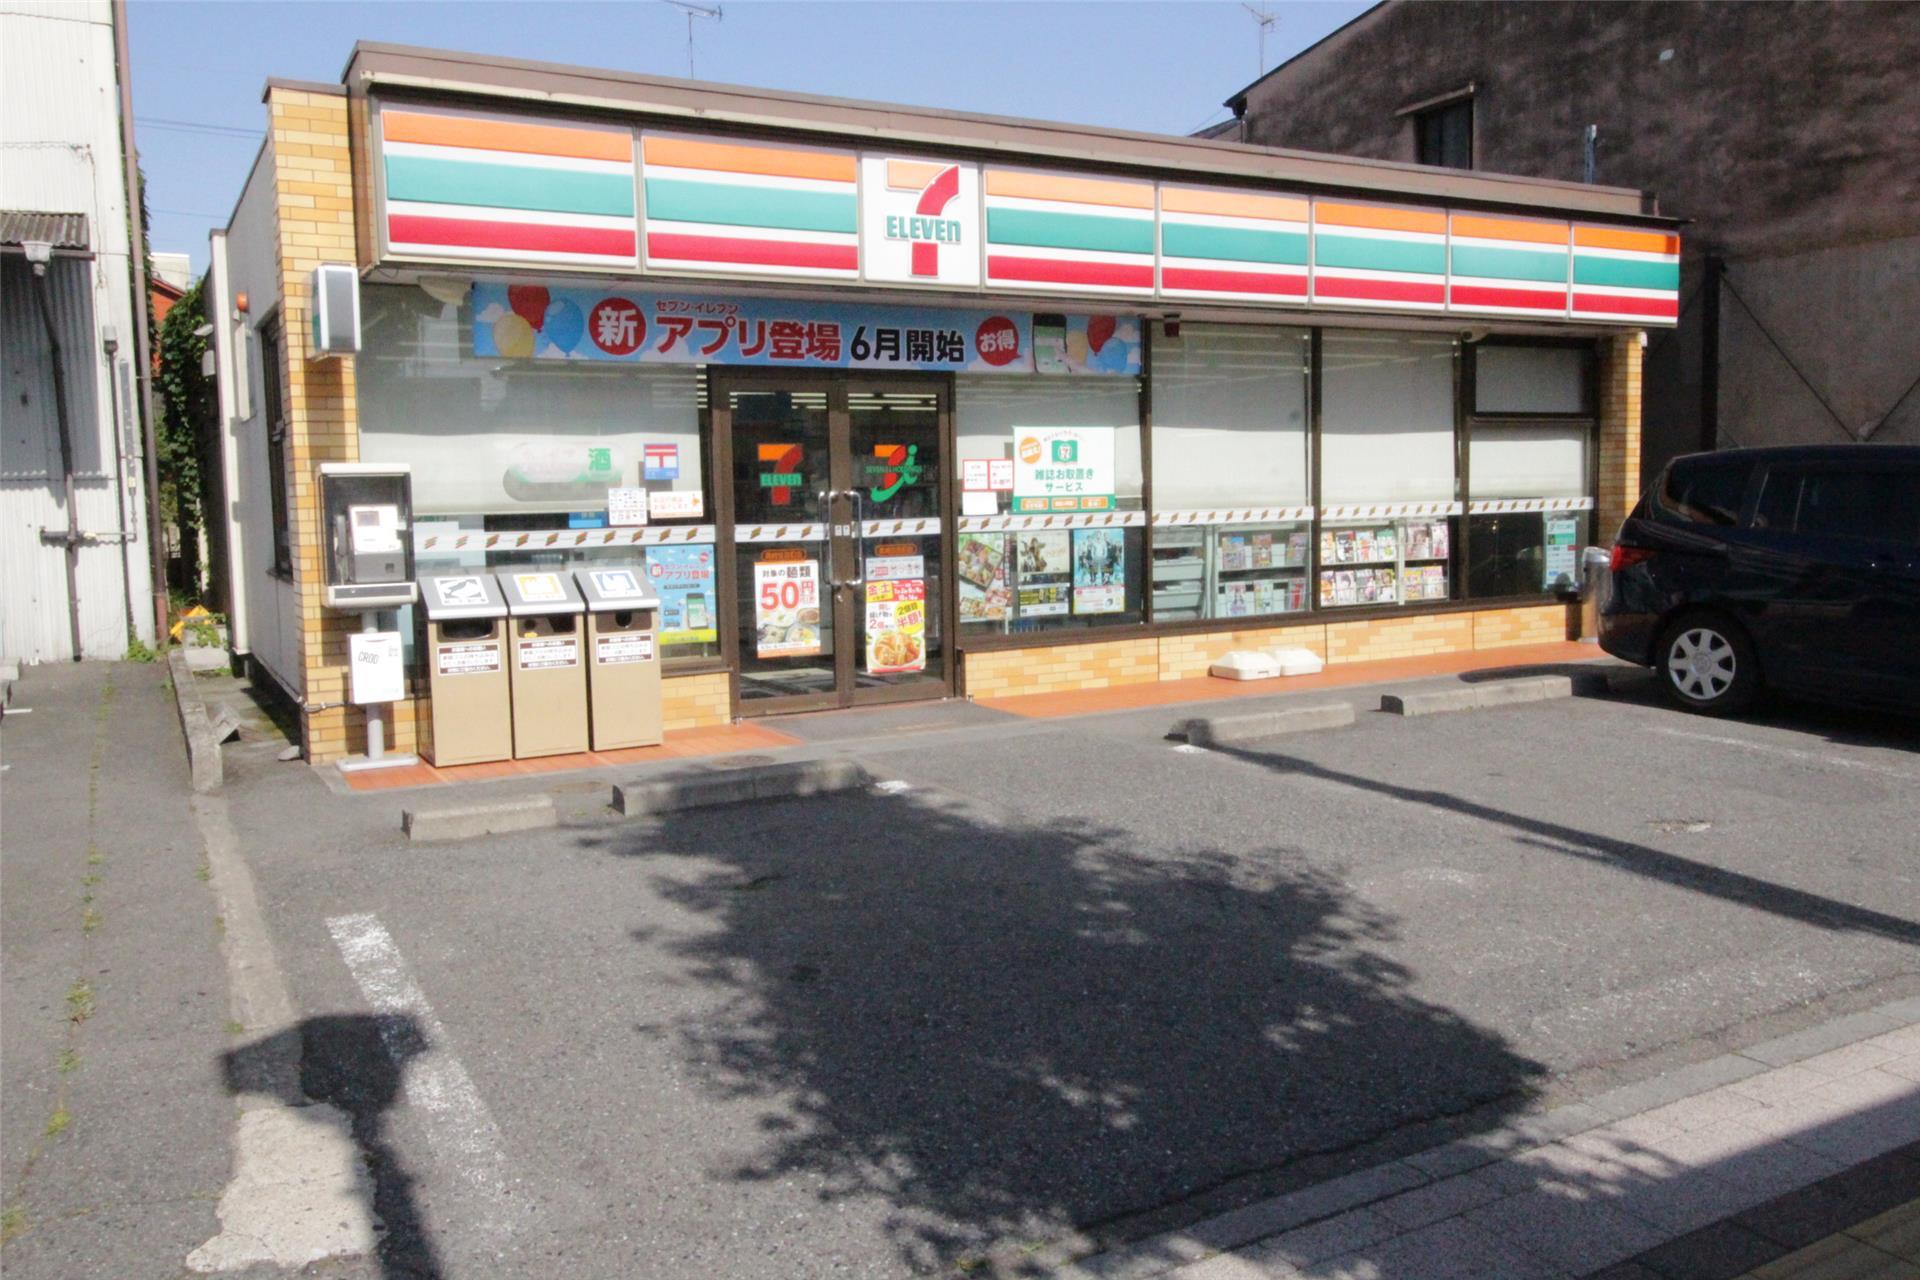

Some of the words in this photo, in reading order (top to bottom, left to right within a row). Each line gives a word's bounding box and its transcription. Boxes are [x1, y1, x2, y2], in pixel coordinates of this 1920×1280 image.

[598, 306, 637, 347] 新
[656, 315, 841, 361] アプリ登場
[850, 325, 965, 363] 6月開始
[979, 328, 1016, 352] お得
[1035, 468, 1094, 481] 雑誌お取置き
[1045, 481, 1083, 493] サービス
